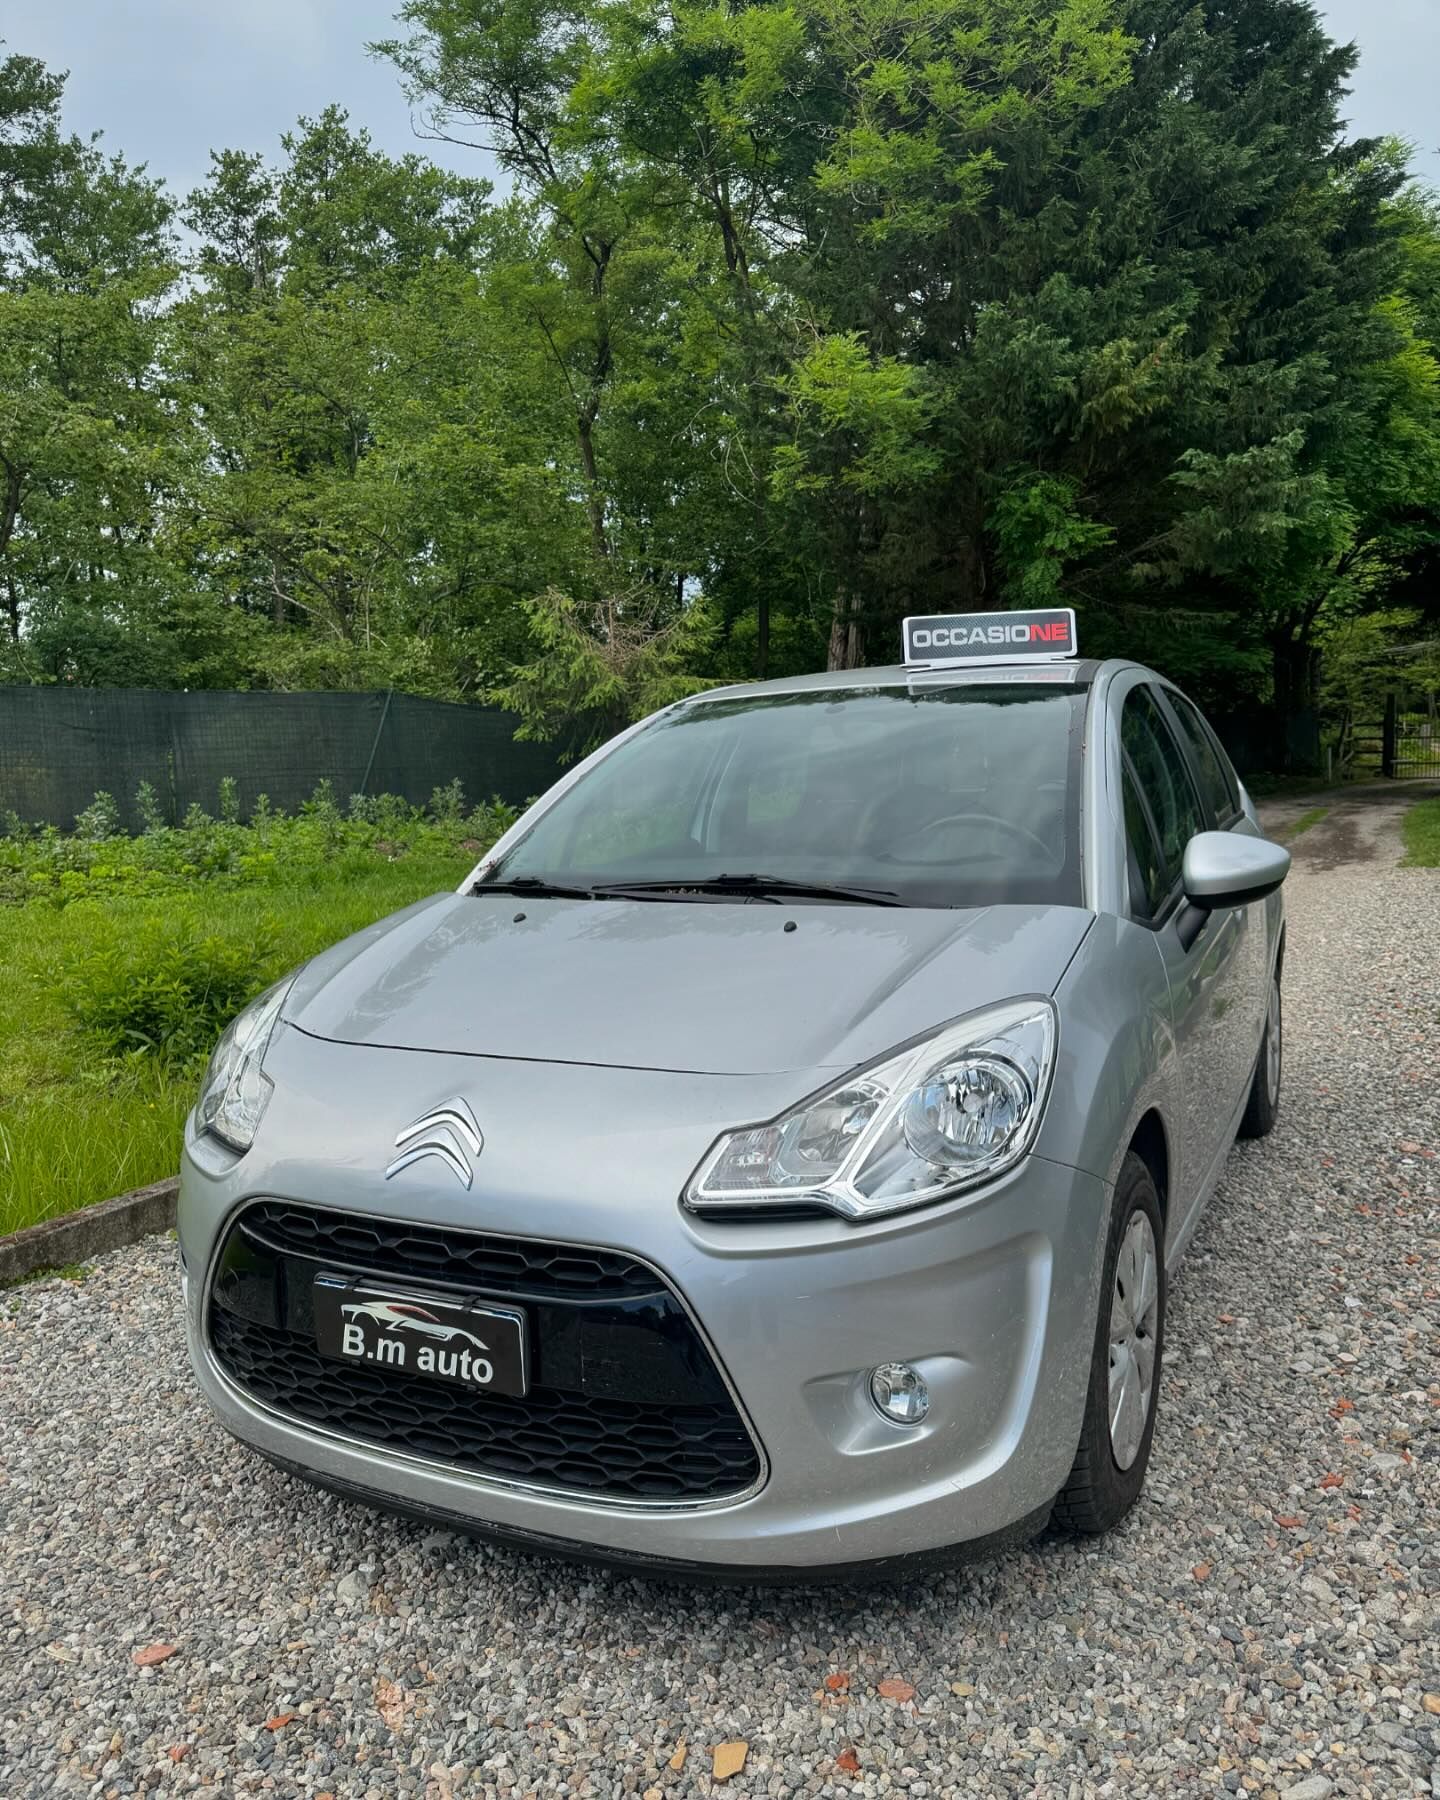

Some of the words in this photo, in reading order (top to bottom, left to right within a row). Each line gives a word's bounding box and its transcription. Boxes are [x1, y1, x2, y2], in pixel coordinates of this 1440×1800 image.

[912, 623, 1069, 648] OCCASIONE
[342, 1323, 405, 1365] B.m
[417, 1346, 494, 1384] auto
